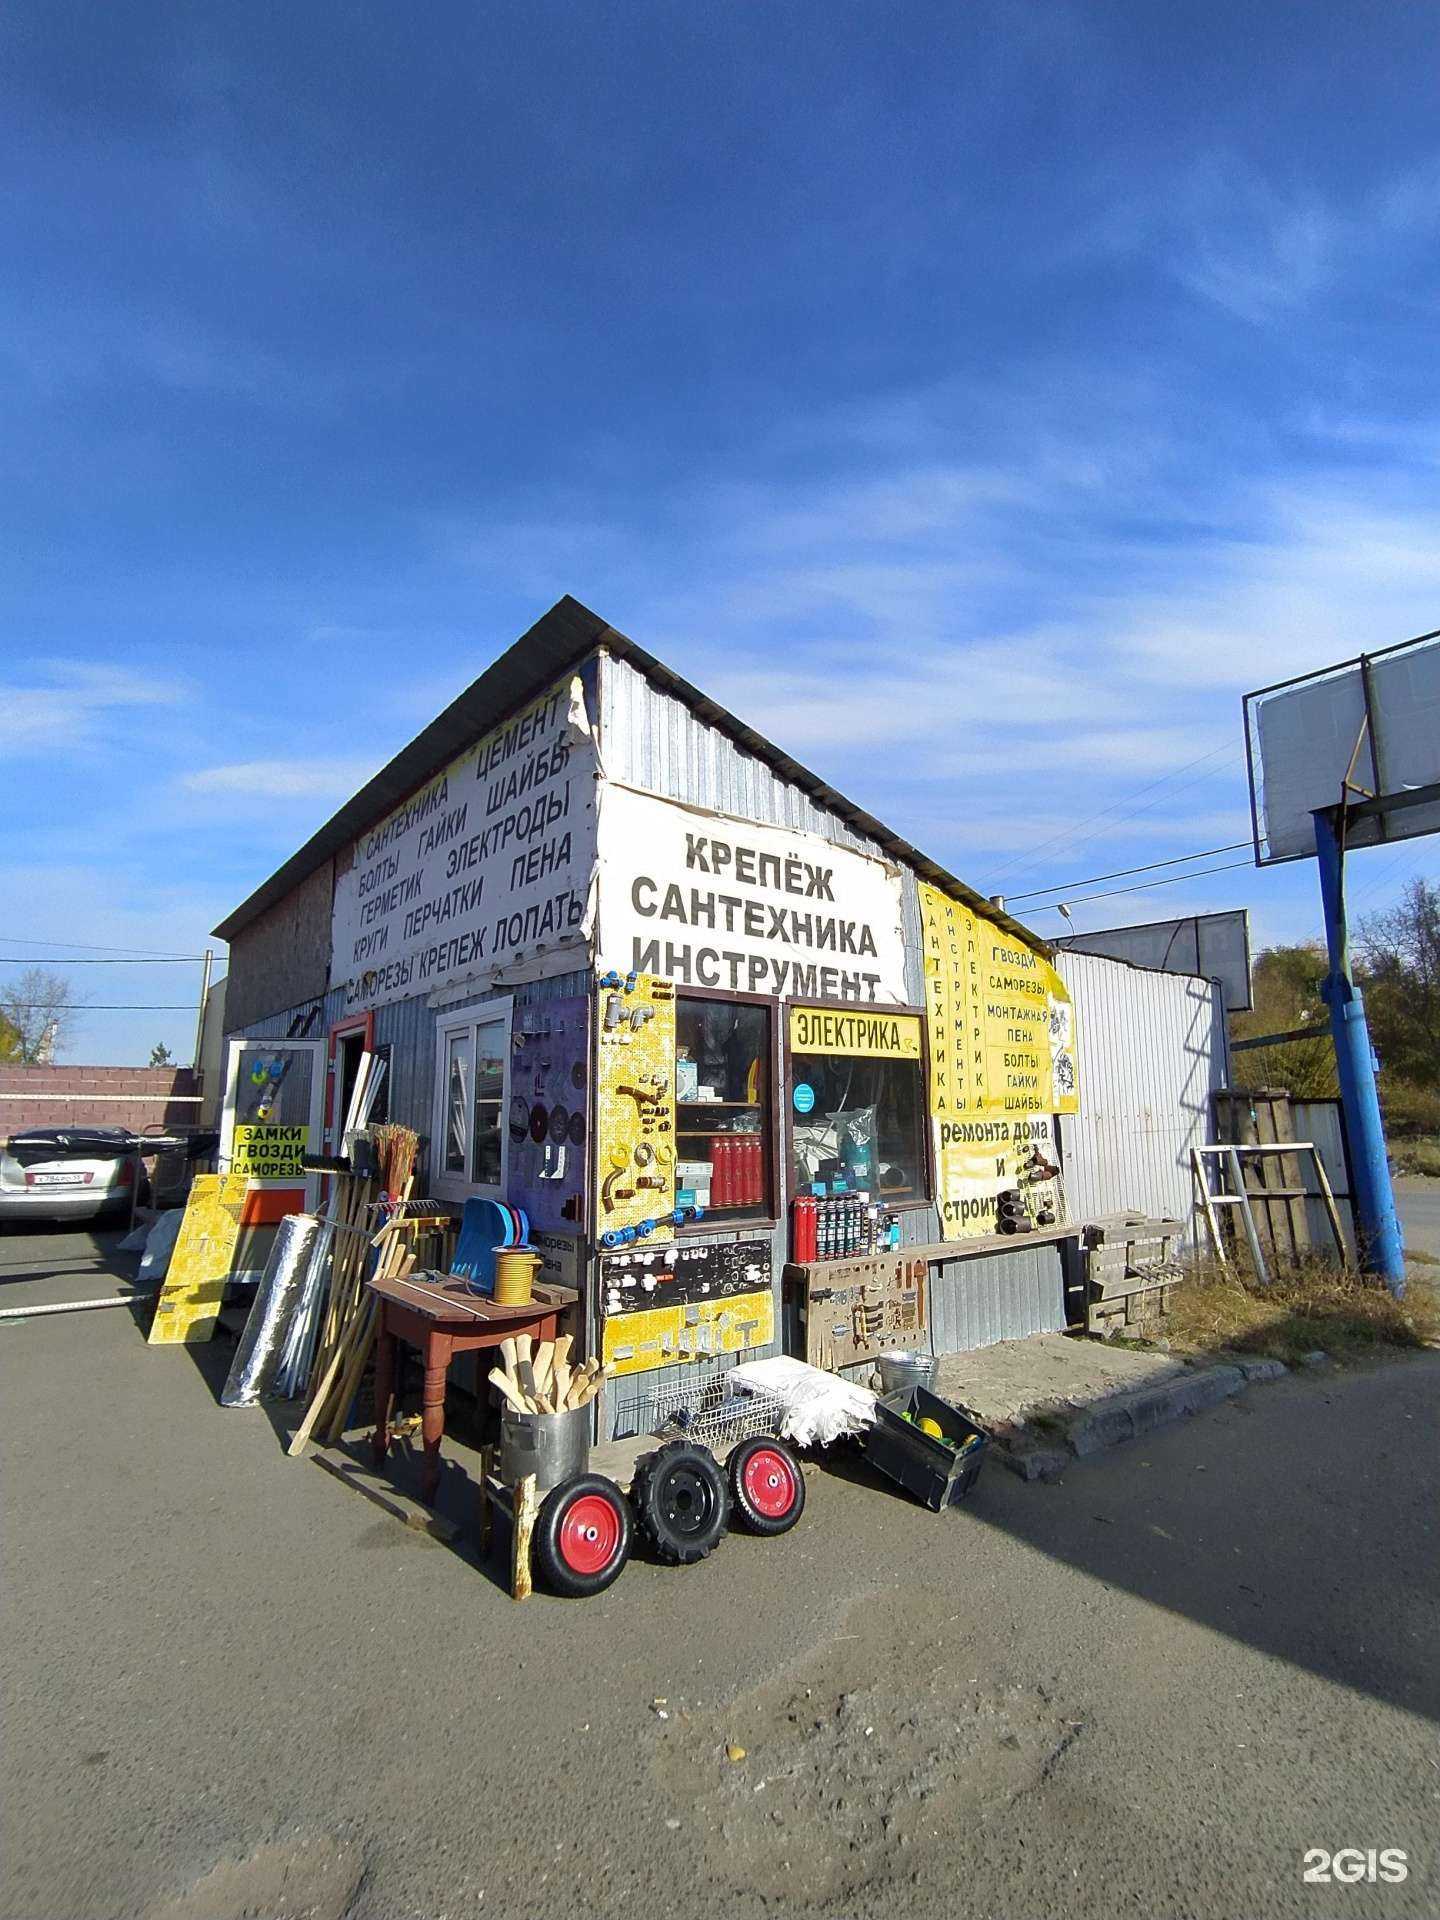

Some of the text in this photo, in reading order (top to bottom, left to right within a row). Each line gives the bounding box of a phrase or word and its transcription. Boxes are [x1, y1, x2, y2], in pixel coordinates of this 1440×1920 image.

[366, 689, 563, 860] САНТЕХНИКА ЦЕМЕНТ
[358, 851, 400, 897] БОЛТЫ
[417, 803, 468, 859] ГАЙКИ
[360, 781, 570, 928] ГЕРМЕТИК ЭЛЕКТРОДЫ
[685, 832, 835, 902] КРЕПЁЖ
[353, 831, 572, 963] КРУГИ ПЕРЧАТКИ ПЕНА
[631, 875, 878, 958] САНТЕХНИКА
[418, 930, 486, 976] КРЕПЕЖ
[632, 936, 882, 1003] ИНСТРУМЕНТ
[991, 945, 1036, 969] ГВОЗДИ
[924, 892, 947, 1111] САНТЕХНИКА
[988, 975, 1045, 996] САМОРЕЗЫ
[944, 905, 967, 1110] ИНСТРУМЕНТЫ
[965, 918, 984, 1111] ЭЛЕКТРИКА
[797, 1013, 902, 1051] ЭЛЕКТРИКА
[1007, 1027, 1034, 1043] ПЕНА
[1003, 1052, 1039, 1069] БОЛТЫ
[1006, 1073, 1038, 1089] ГАЙКИ
[1004, 1094, 1043, 1111] ШАЙБЫ
[237, 1143, 306, 1161] ГВОЗДИ
[243, 1127, 302, 1142] ЗАМКИ
[940, 1120, 1048, 1150] ремонта дома
[943, 1196, 997, 1227] строит
